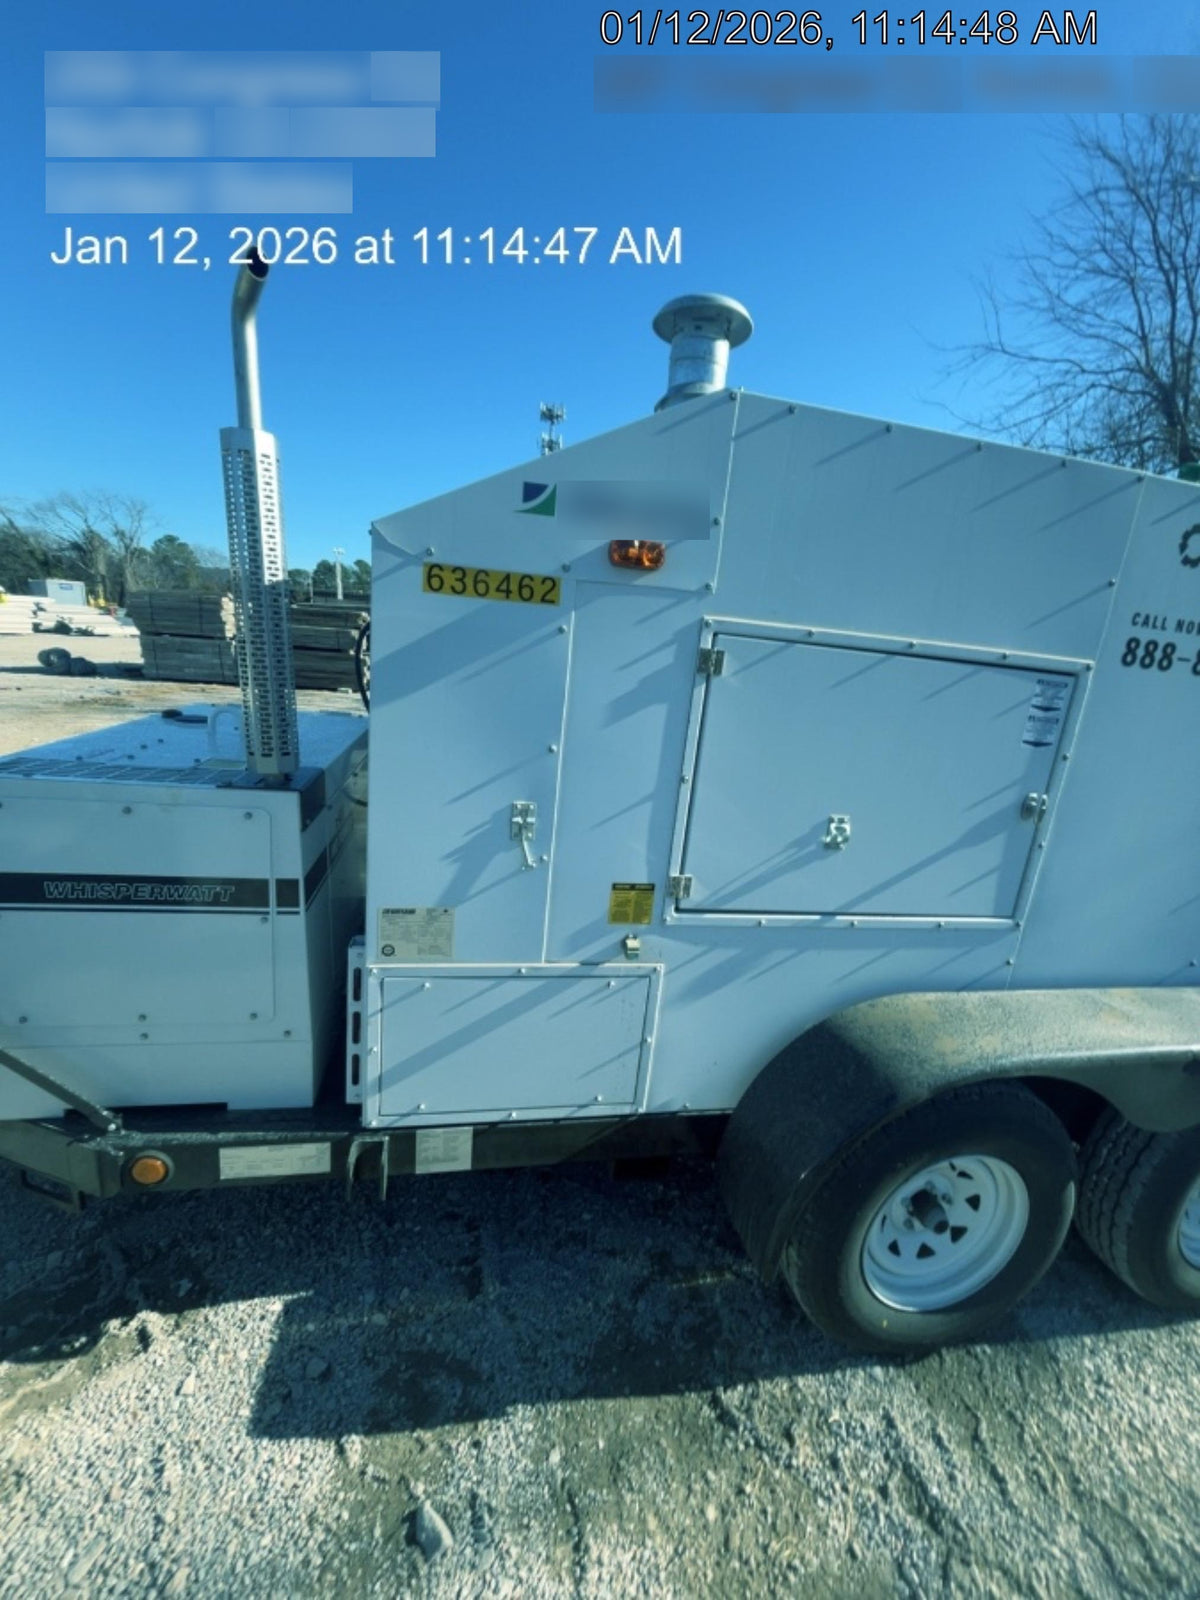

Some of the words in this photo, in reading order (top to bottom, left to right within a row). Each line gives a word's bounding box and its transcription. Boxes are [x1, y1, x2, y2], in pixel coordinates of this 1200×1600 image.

[426, 563, 557, 604] 636462
[1131, 612, 1168, 631] CALL
[1175, 618, 1200, 636] NO
[43, 880, 235, 902] WHISPERWATT
